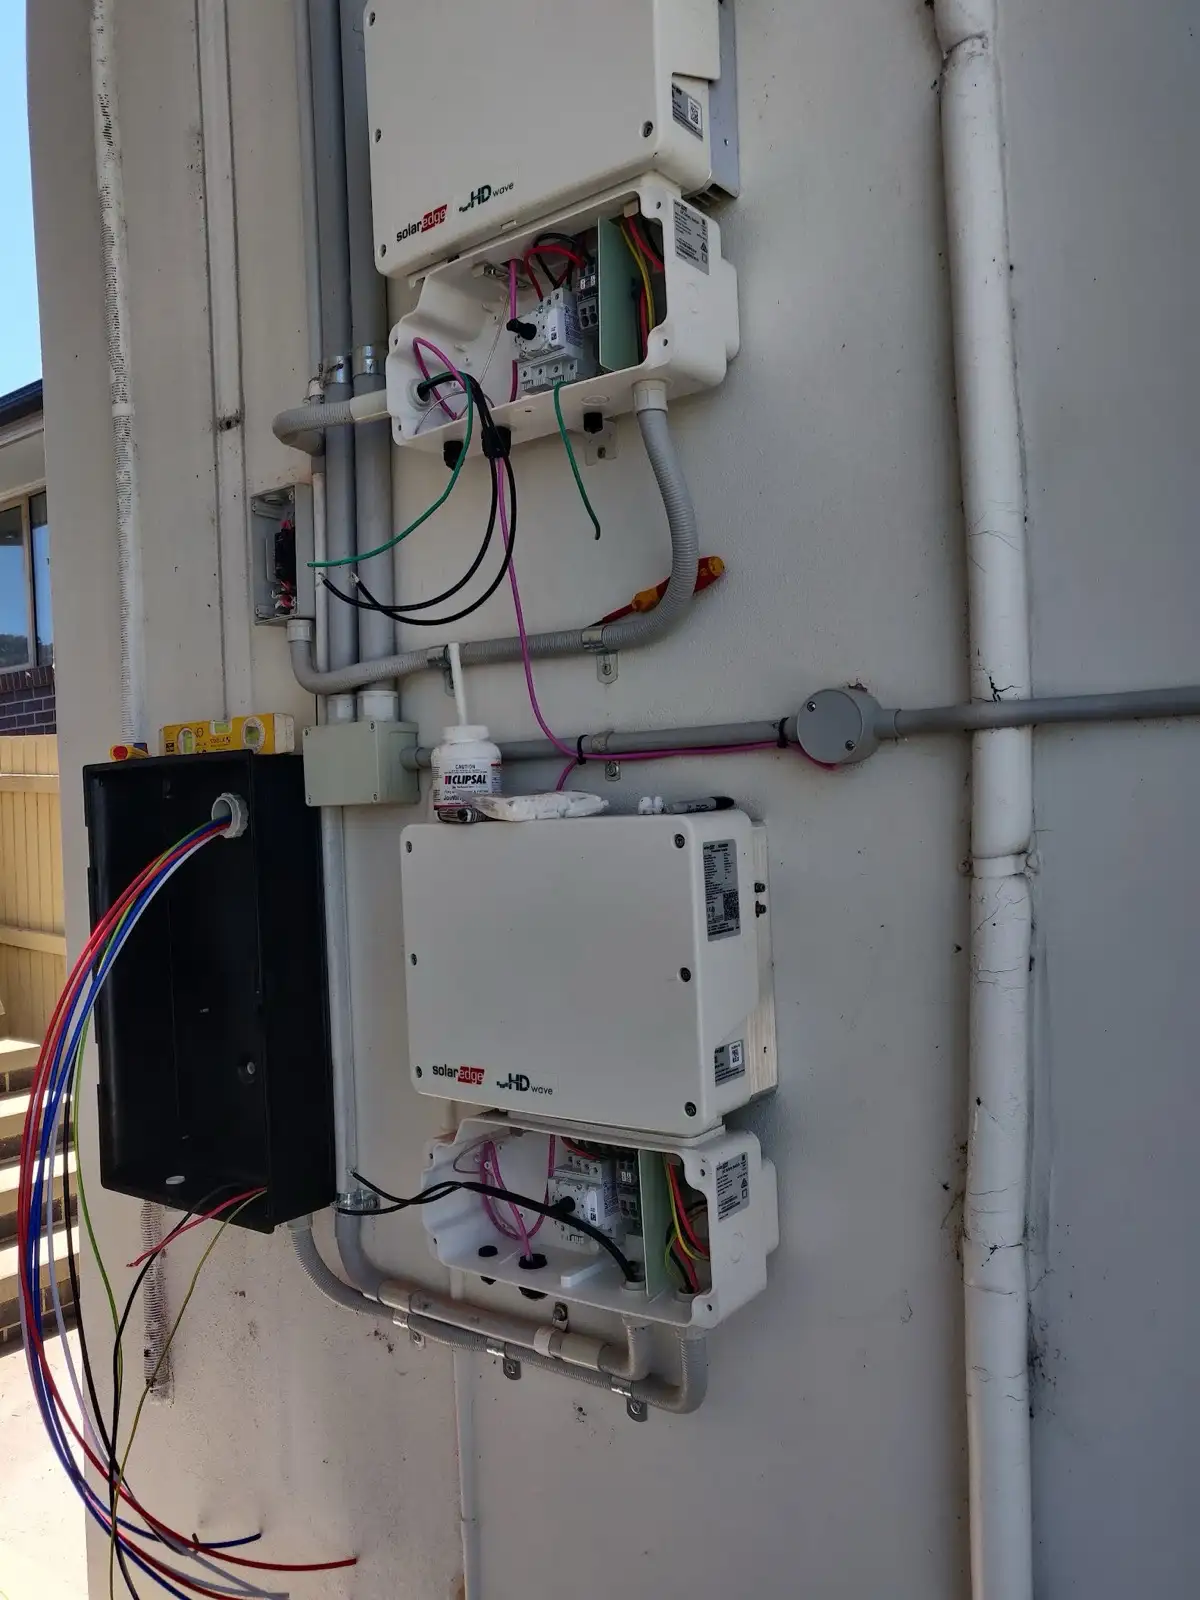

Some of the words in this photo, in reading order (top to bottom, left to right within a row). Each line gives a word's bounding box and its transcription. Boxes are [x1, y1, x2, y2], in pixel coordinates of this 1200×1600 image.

[396, 204, 447, 242] solaredge
[468, 184, 492, 209] HD
[492, 182, 514, 197] wave
[452, 775, 486, 784] CLIPSAL
[432, 1064, 484, 1085] solaredge
[506, 1072, 530, 1092] HD
[531, 1084, 553, 1096] wave
